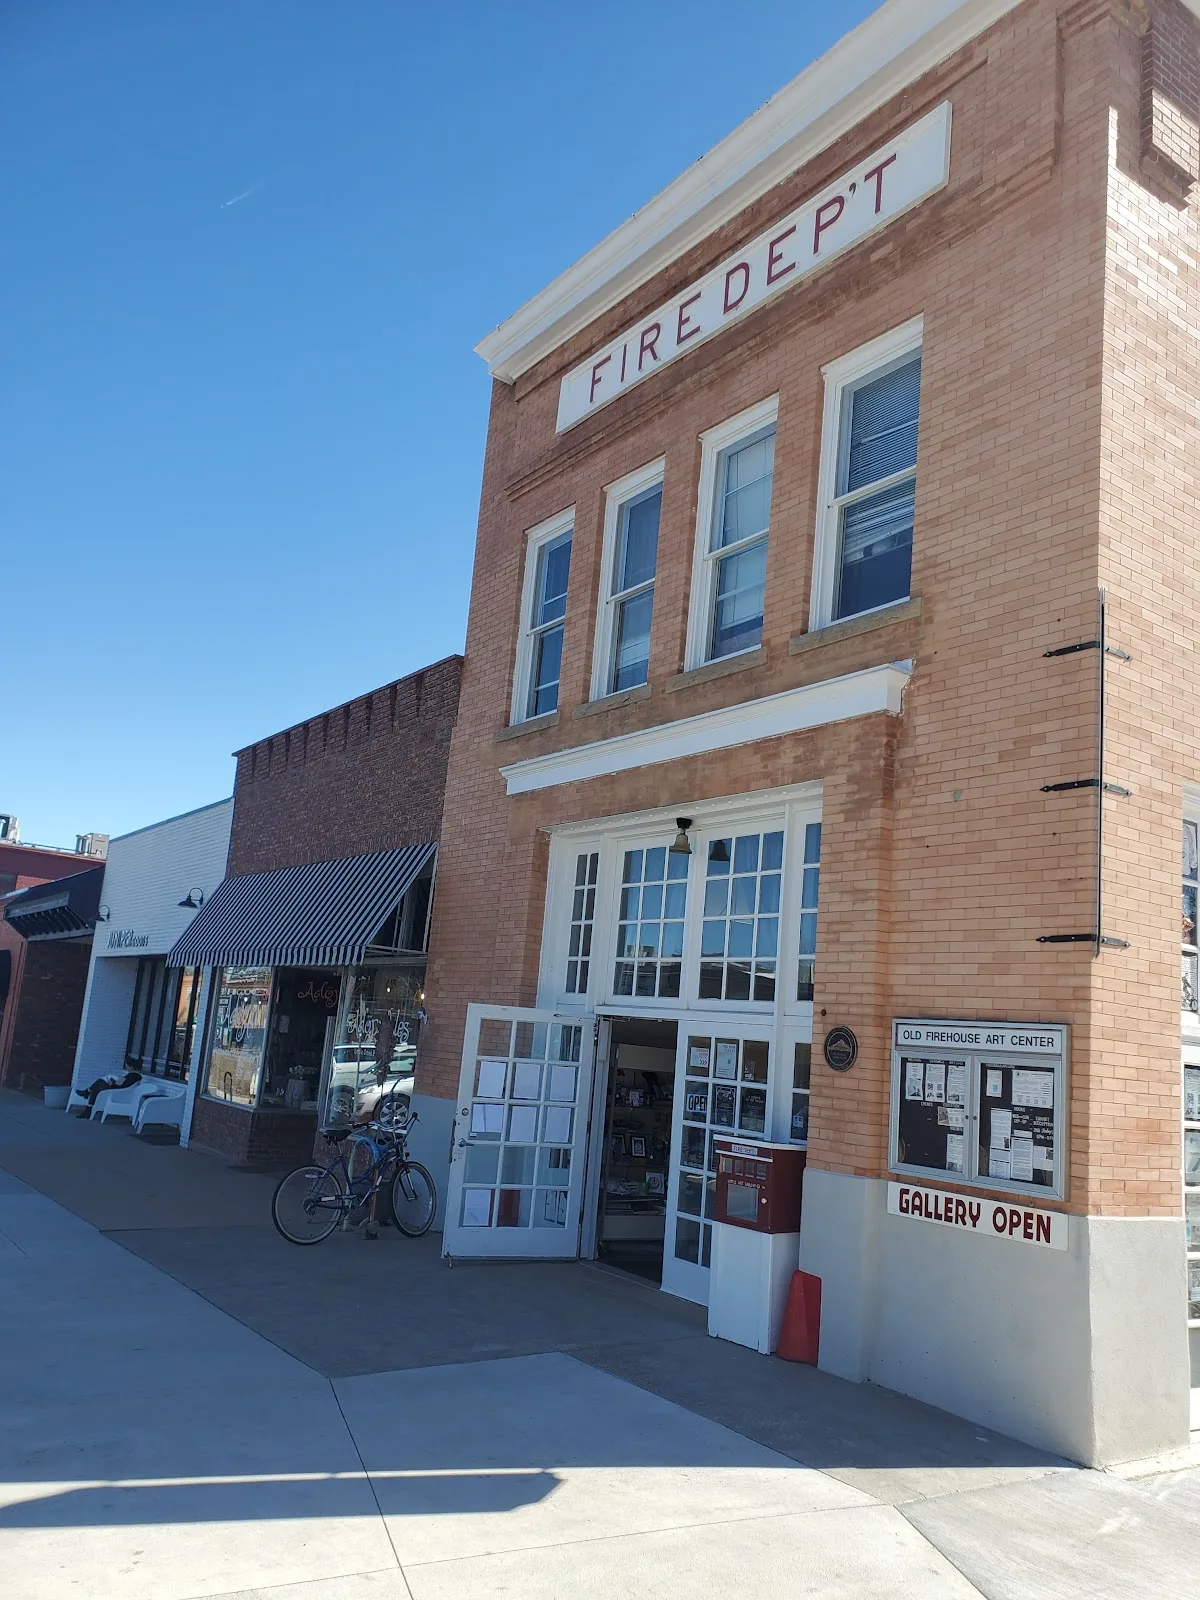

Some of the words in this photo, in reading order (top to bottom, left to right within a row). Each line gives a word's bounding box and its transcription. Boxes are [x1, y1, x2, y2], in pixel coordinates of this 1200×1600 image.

[589, 291, 702, 404] FIRE
[722, 153, 897, 316] DEP'T
[903, 1030, 922, 1041] OLD
[925, 1031, 981, 1044] FIREHOUSE
[985, 1034, 1006, 1046] ART
[1010, 1035, 1055, 1048] CENTER
[899, 1187, 981, 1228] GALLERY
[991, 1206, 1052, 1244] OPEN
